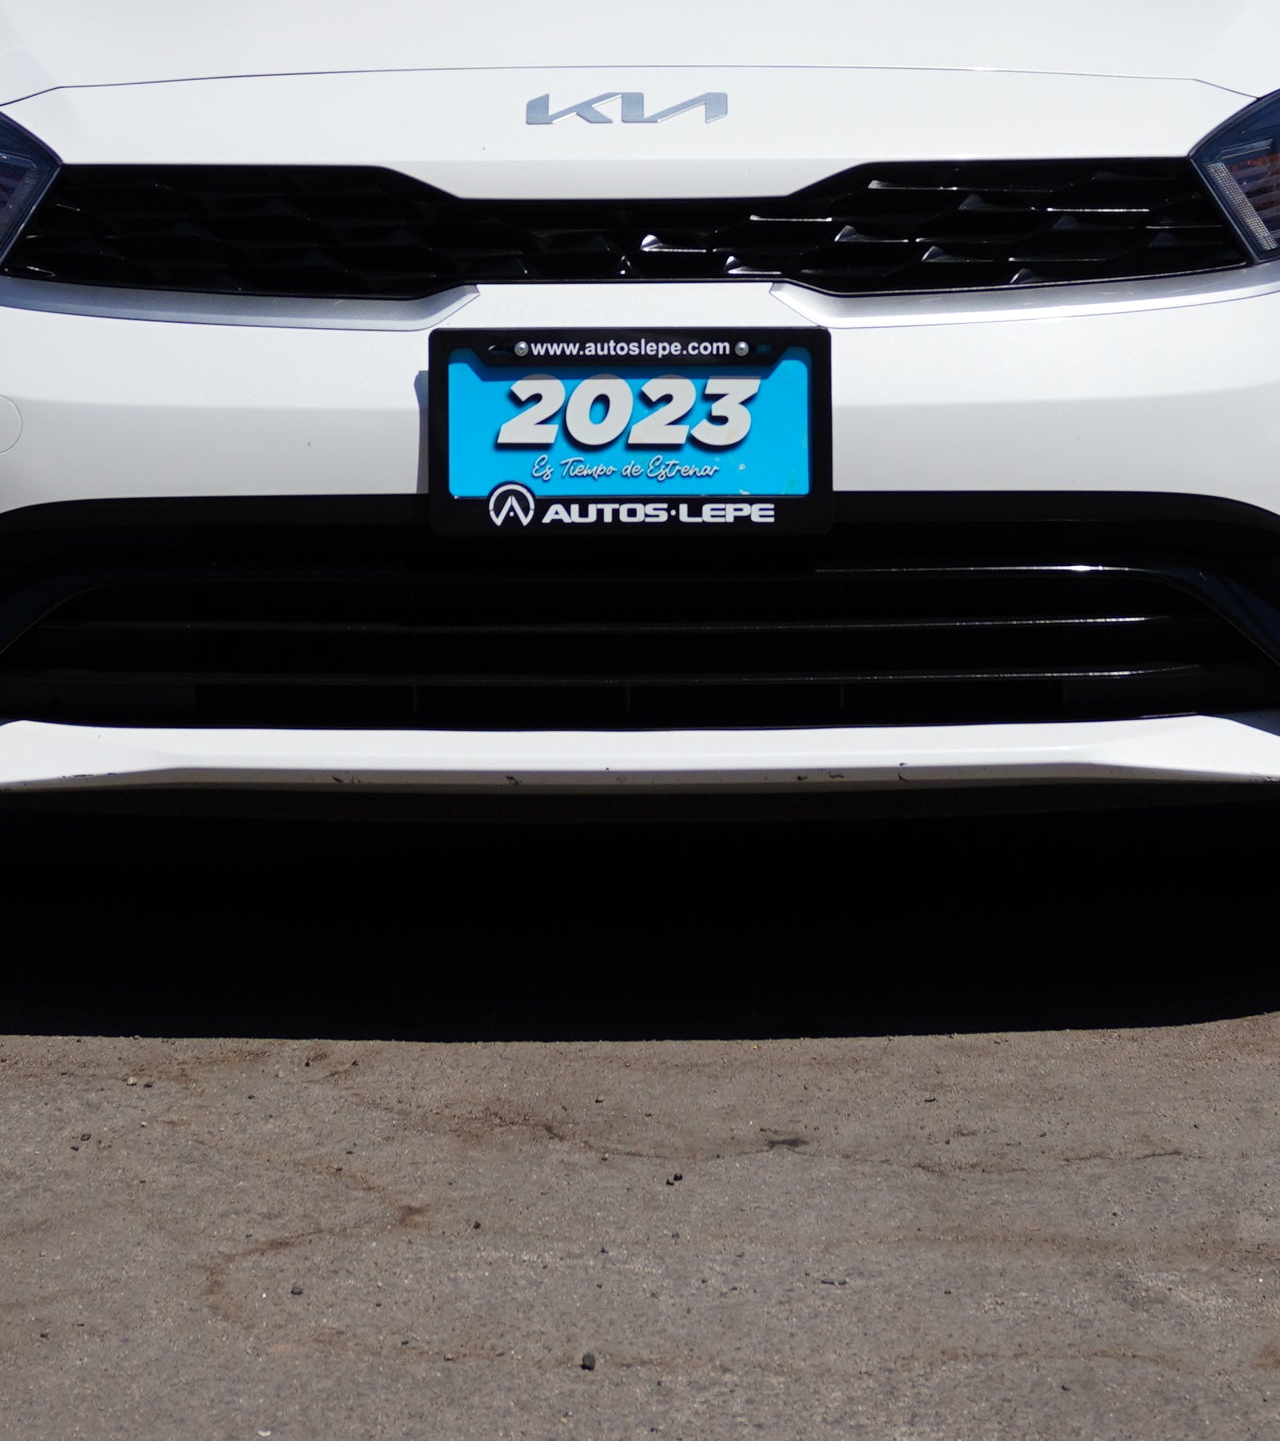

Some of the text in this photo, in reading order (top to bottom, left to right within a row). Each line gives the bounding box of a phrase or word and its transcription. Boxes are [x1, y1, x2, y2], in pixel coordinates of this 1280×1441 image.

[525, 92, 728, 124] KIA
[531, 338, 730, 358] www.autoslepe.com
[497, 374, 761, 446] 2023
[532, 454, 720, 481] Es Tiempo de Estrenar
